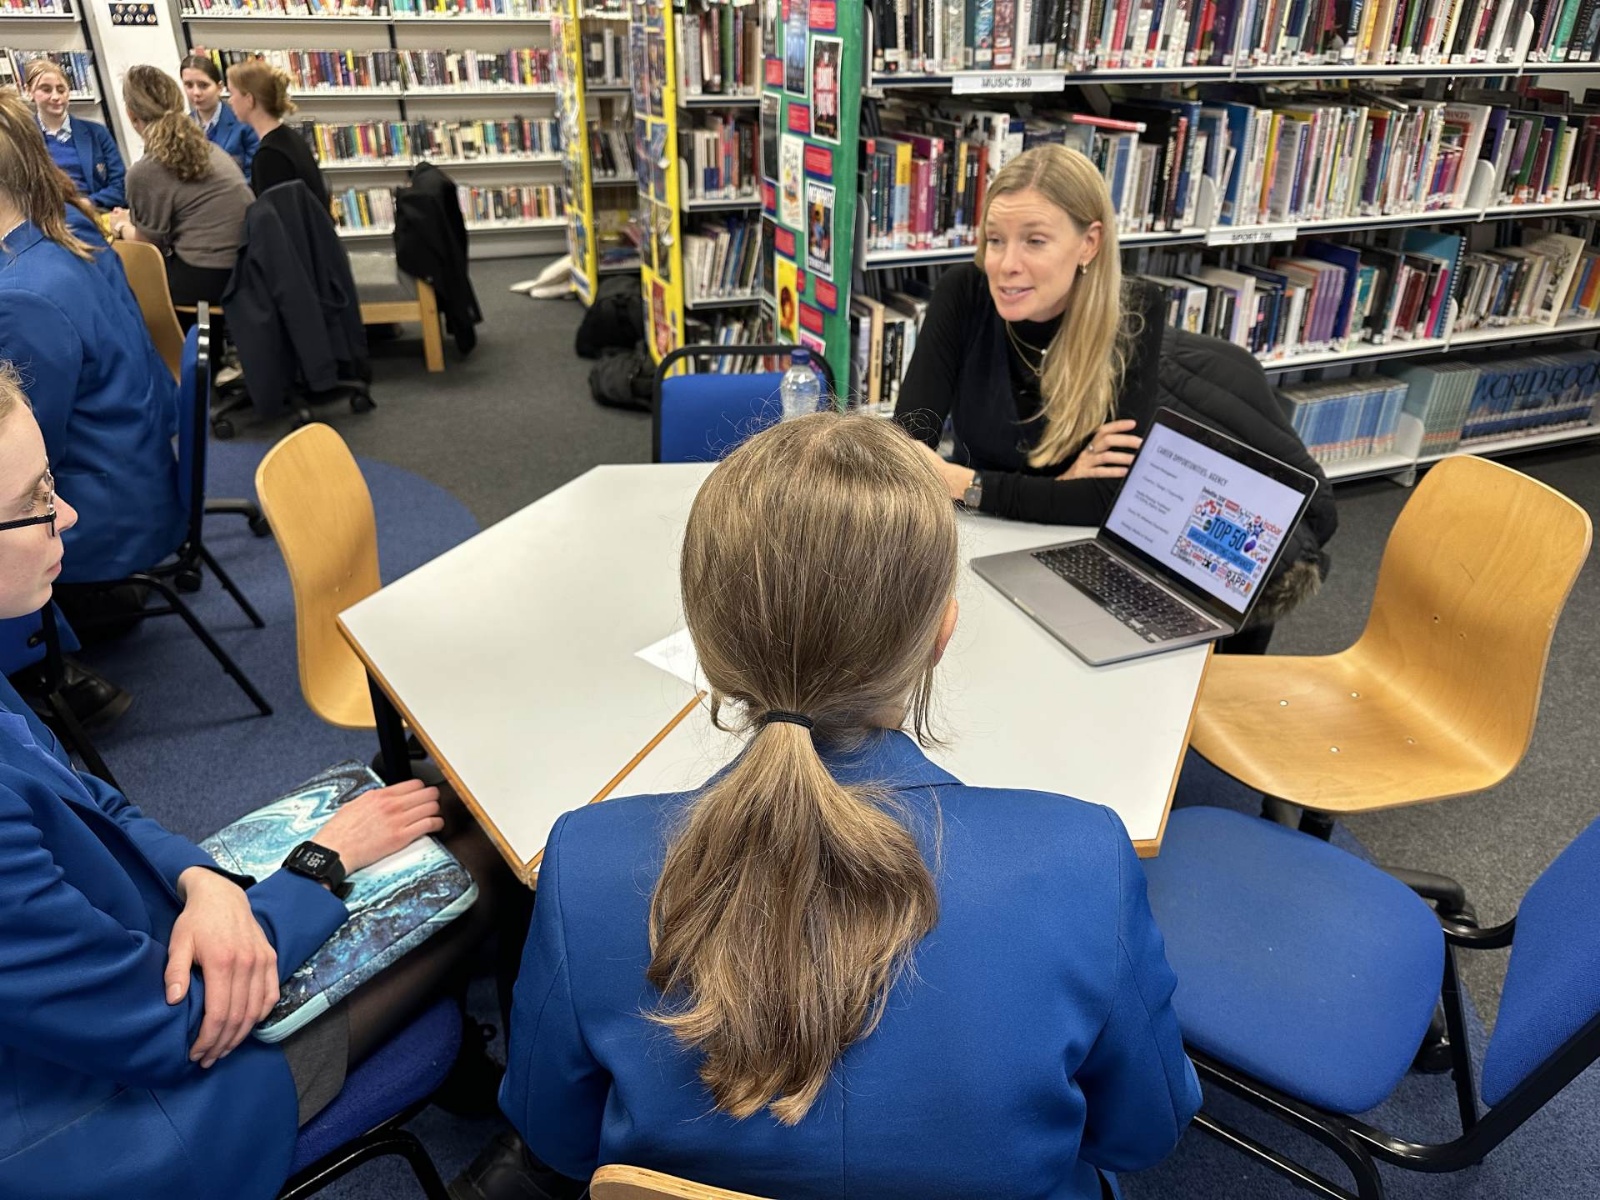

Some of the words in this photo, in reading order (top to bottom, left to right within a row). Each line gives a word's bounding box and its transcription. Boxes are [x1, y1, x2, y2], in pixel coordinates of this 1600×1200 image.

[982, 77, 1013, 88] MUSIC
[1015, 76, 1032, 87] 780
[1208, 472, 1229, 487] AGENCY
[1209, 517, 1232, 541] TOP
[1228, 529, 1247, 551] 50
[1225, 570, 1247, 588] RAPP
